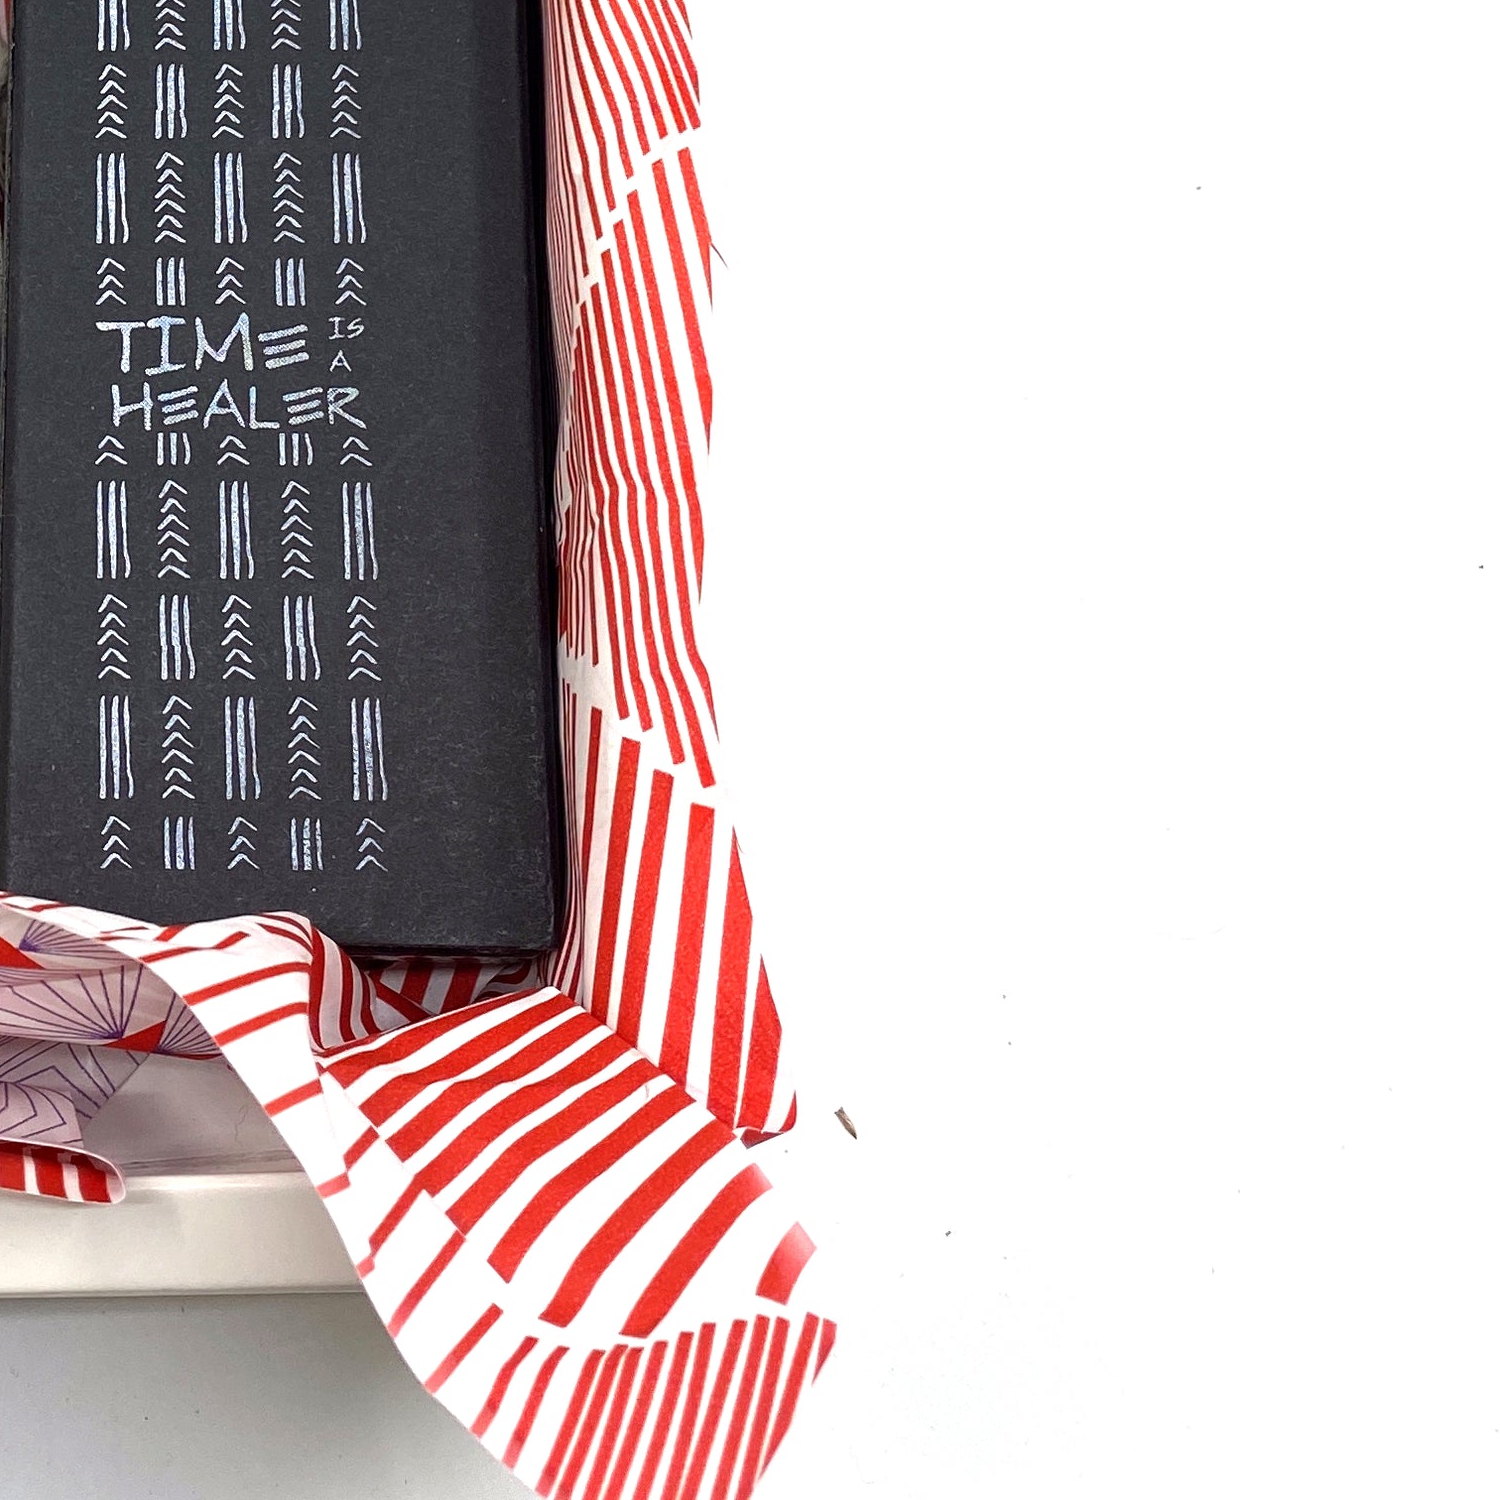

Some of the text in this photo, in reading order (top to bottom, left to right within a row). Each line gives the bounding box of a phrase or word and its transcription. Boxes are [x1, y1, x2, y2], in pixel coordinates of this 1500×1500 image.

[95, 312, 365, 377] TIME IS
[329, 349, 352, 373] A
[111, 378, 368, 431] HEALER
